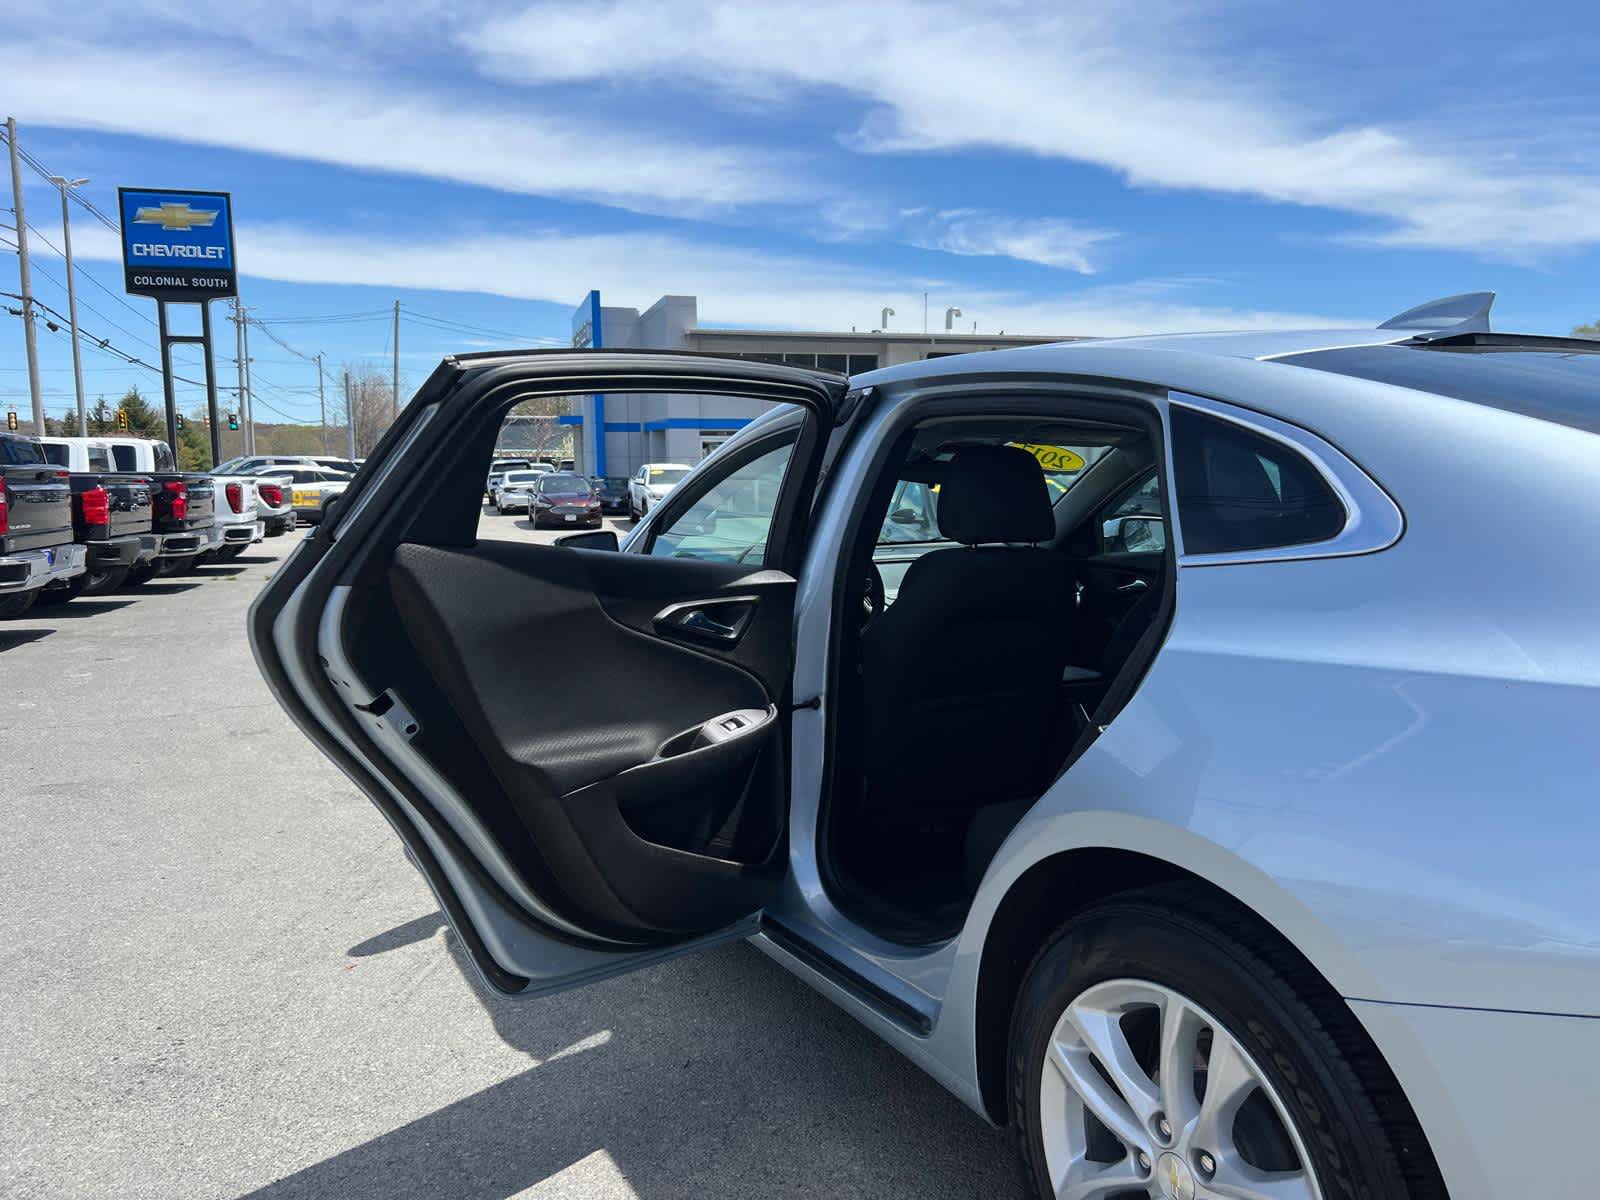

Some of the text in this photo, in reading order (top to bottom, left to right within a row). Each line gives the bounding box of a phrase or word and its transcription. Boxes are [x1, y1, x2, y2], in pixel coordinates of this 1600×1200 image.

[132, 243, 225, 259] CHEVROLET
[134, 275, 228, 288] COLONIAL SOUTH
